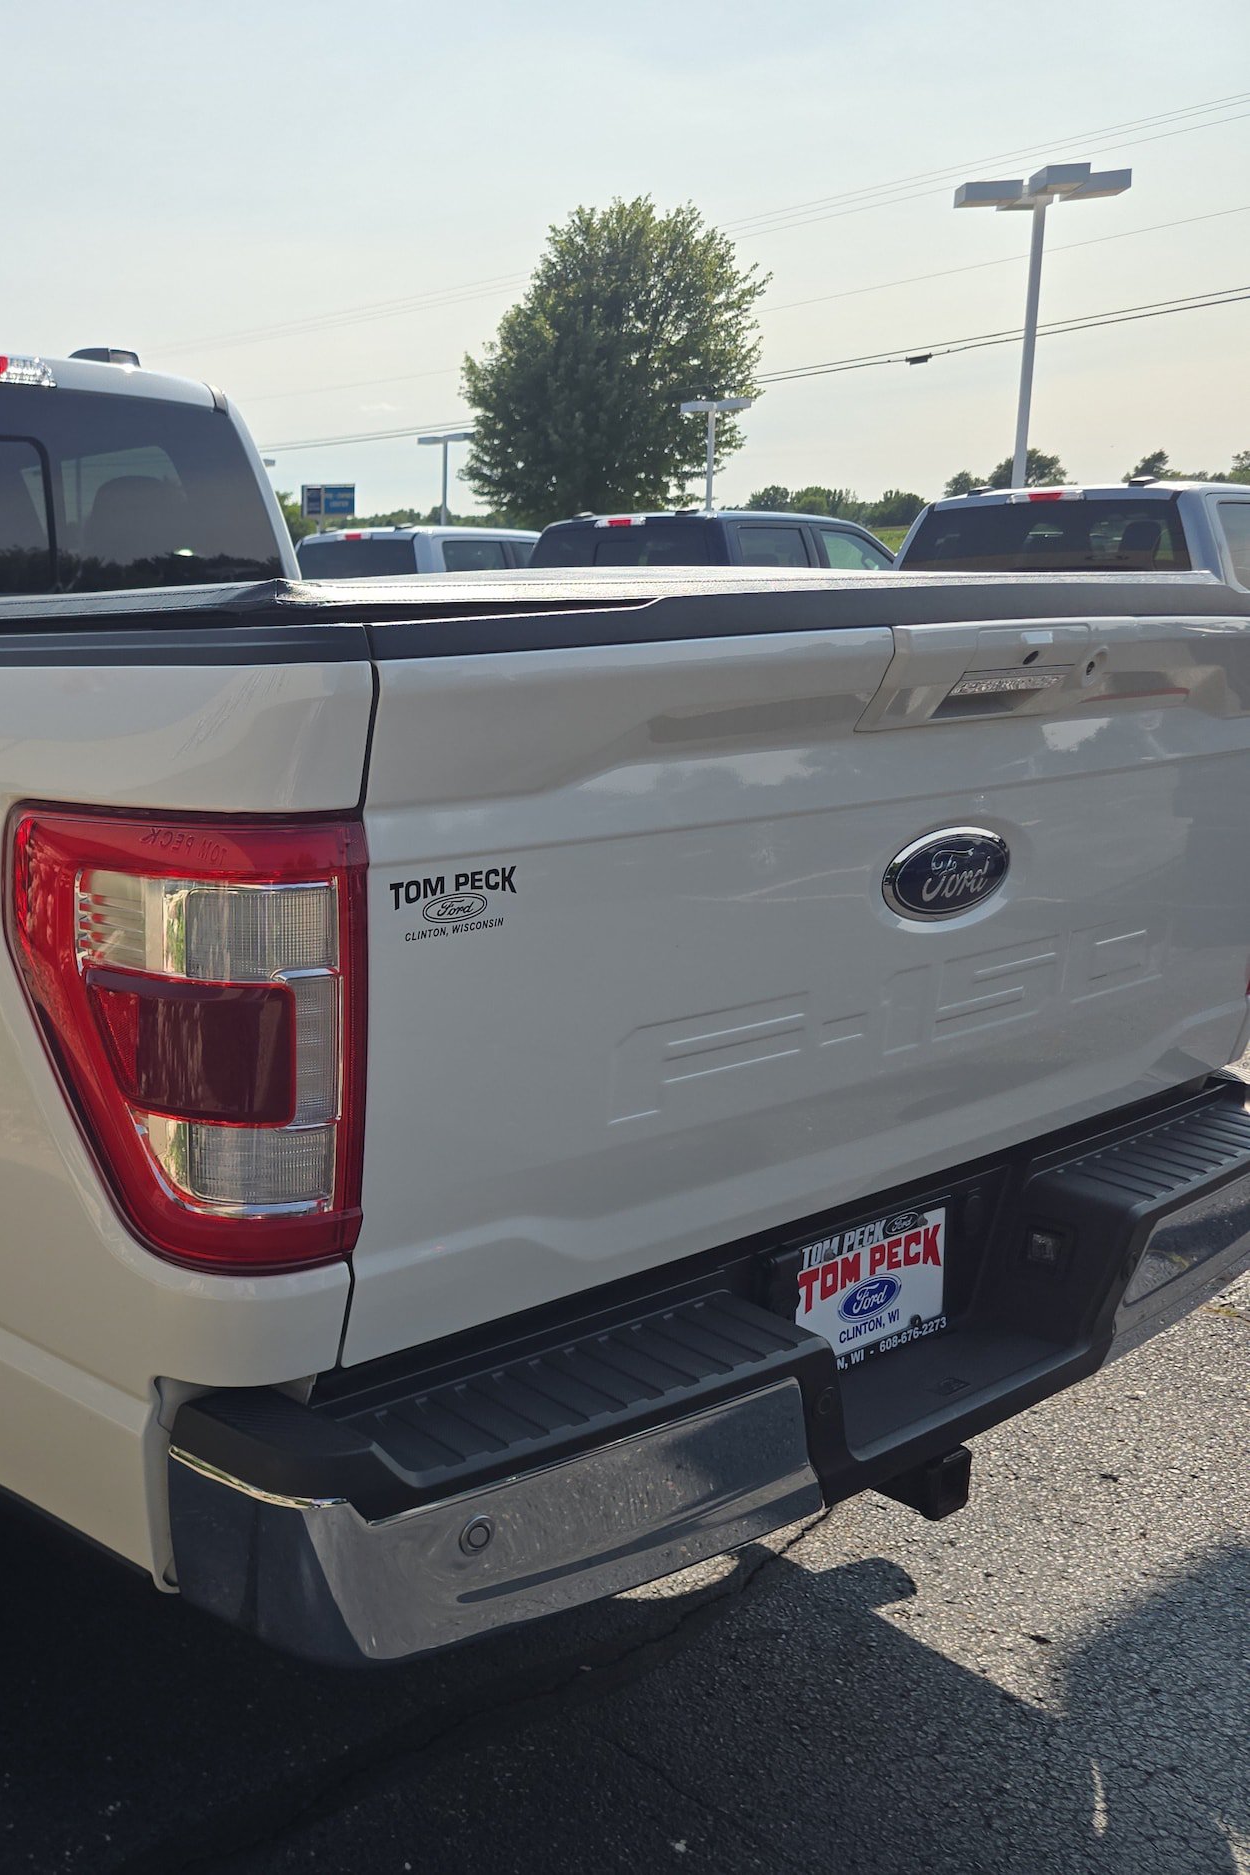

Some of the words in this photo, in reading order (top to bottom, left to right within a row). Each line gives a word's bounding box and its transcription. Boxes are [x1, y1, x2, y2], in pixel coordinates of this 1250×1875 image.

[389, 876, 445, 911] TOM
[455, 866, 517, 894] PECK
[922, 848, 990, 902] Ford
[437, 899, 475, 917] Ford
[405, 926, 449, 942] CLINTON,
[452, 917, 504, 935] WISCONSIN
[891, 1214, 914, 1233] Ford
[802, 1235, 840, 1270] TOM
[843, 1219, 887, 1254] PECK
[798, 1252, 861, 1315] TOM
[869, 1223, 942, 1276] PECK
[852, 1282, 887, 1314] Ford
[839, 1318, 885, 1344] CLINTON,
[888, 1308, 900, 1325] WI
[850, 1349, 865, 1366] WI
[879, 1316, 948, 1353] 608-676-2273
